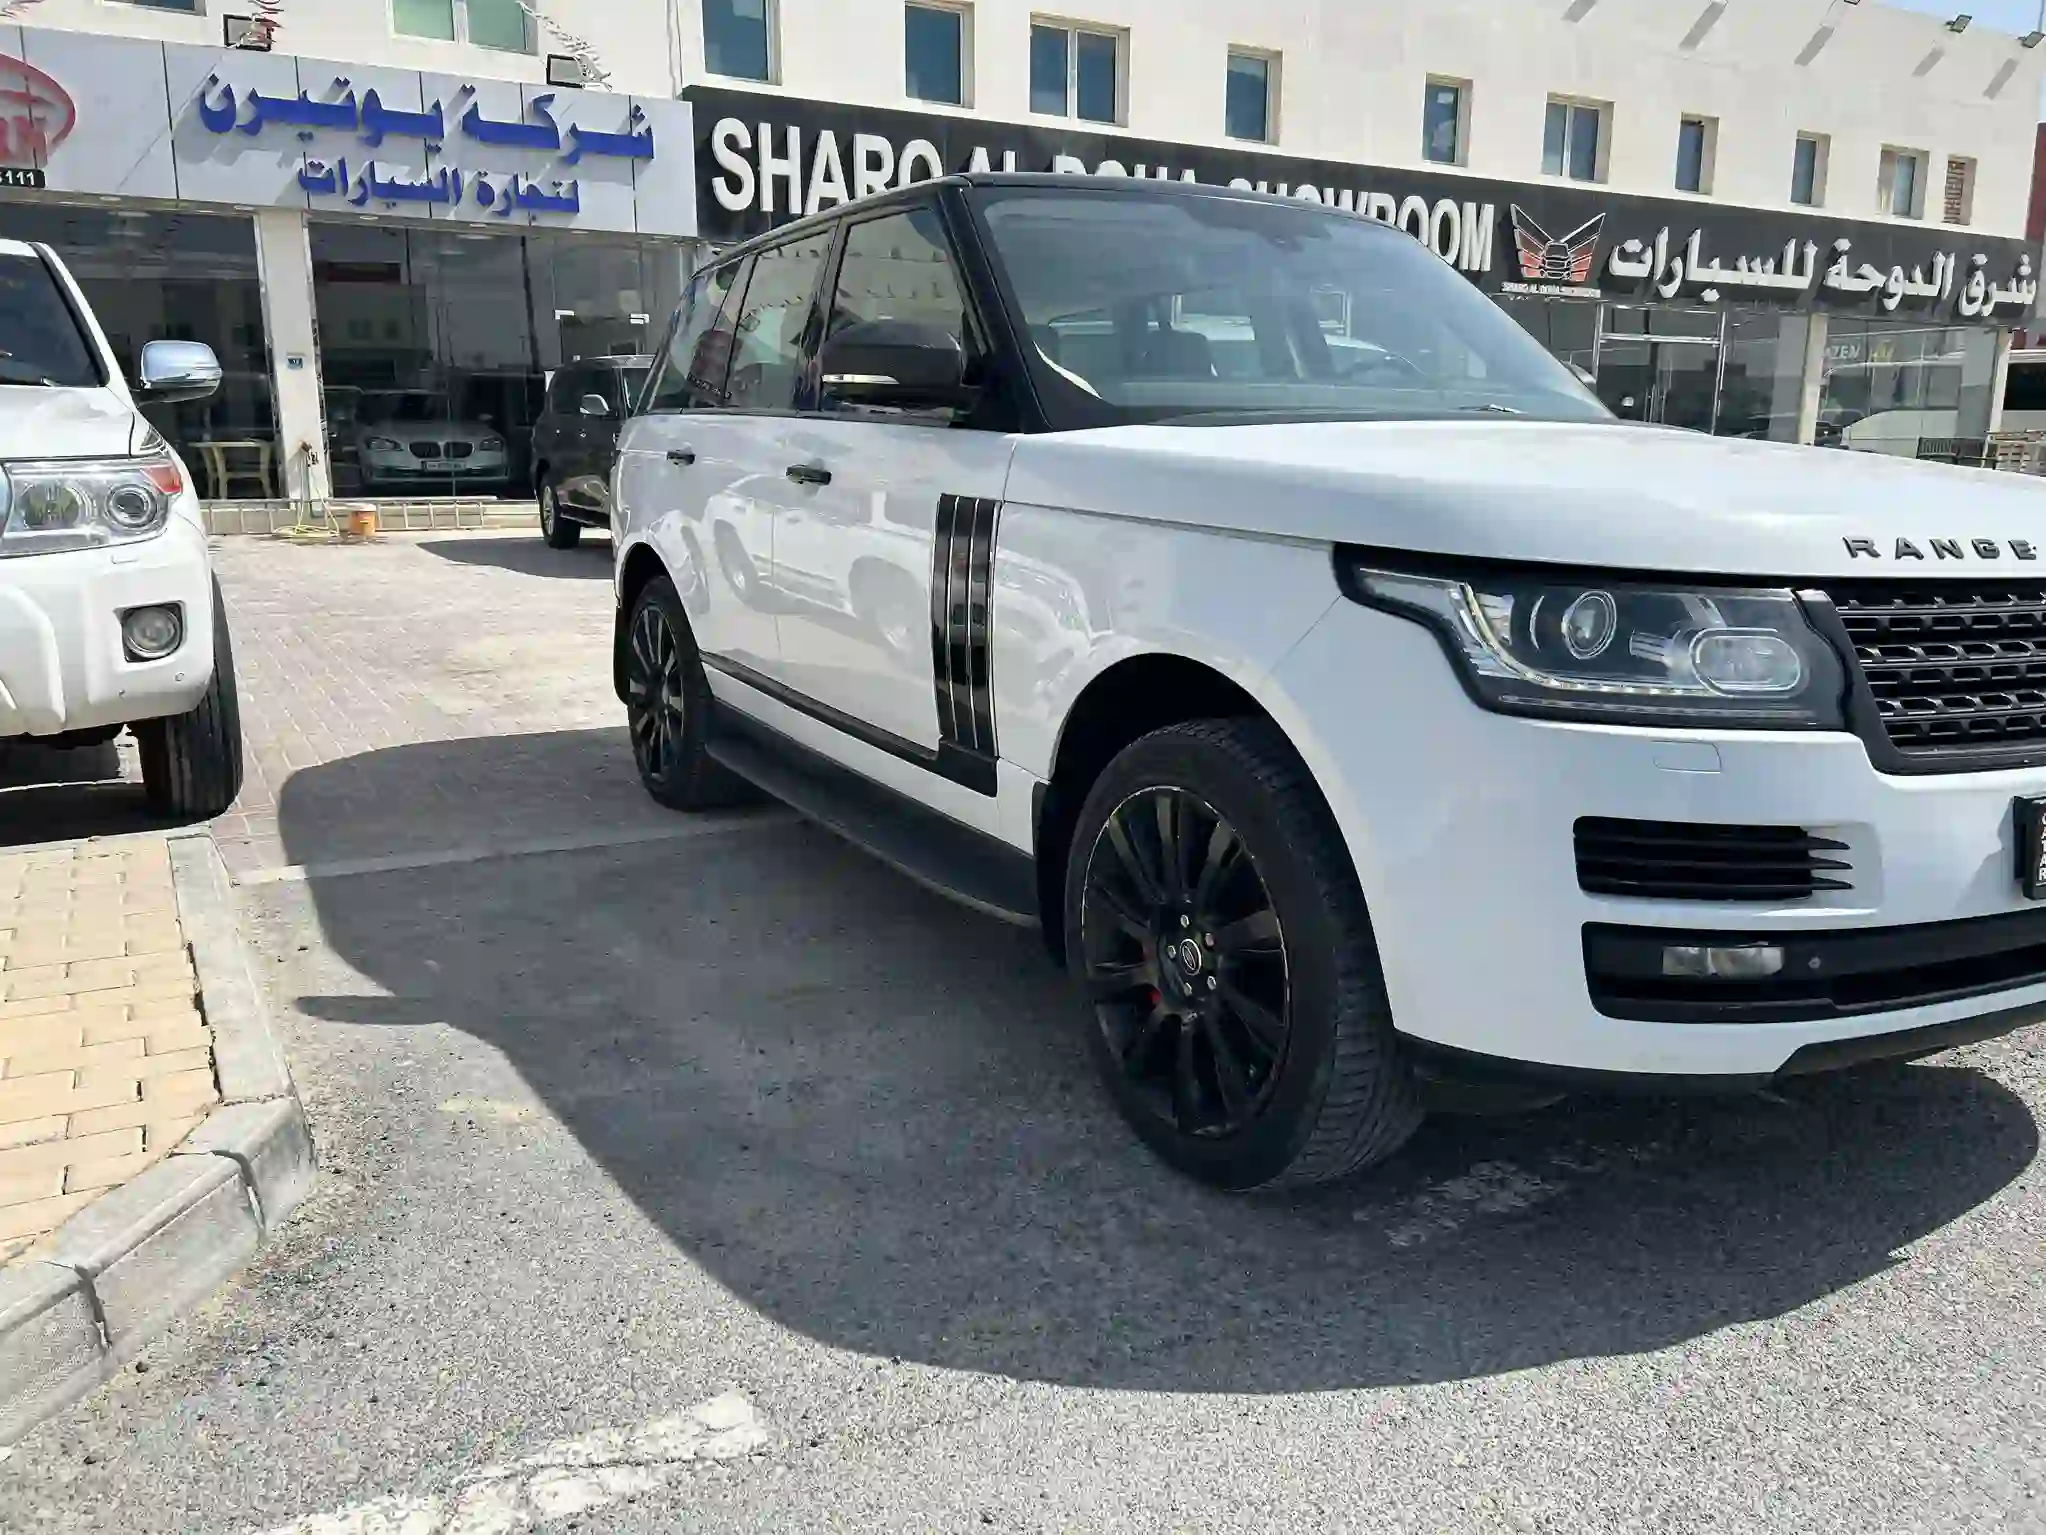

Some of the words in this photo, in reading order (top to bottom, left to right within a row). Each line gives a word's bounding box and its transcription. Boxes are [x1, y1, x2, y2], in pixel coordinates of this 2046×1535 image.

[200, 73, 445, 153] يوتيرن
[461, 84, 655, 166] شركة
[297, 156, 464, 208] السيارات
[477, 170, 580, 222] لتجارة
[1608, 226, 1819, 302] للسيارات
[1823, 238, 1956, 311] الدوحة
[1958, 252, 2037, 317] شرق
[1842, 535, 2037, 561] RANGE
